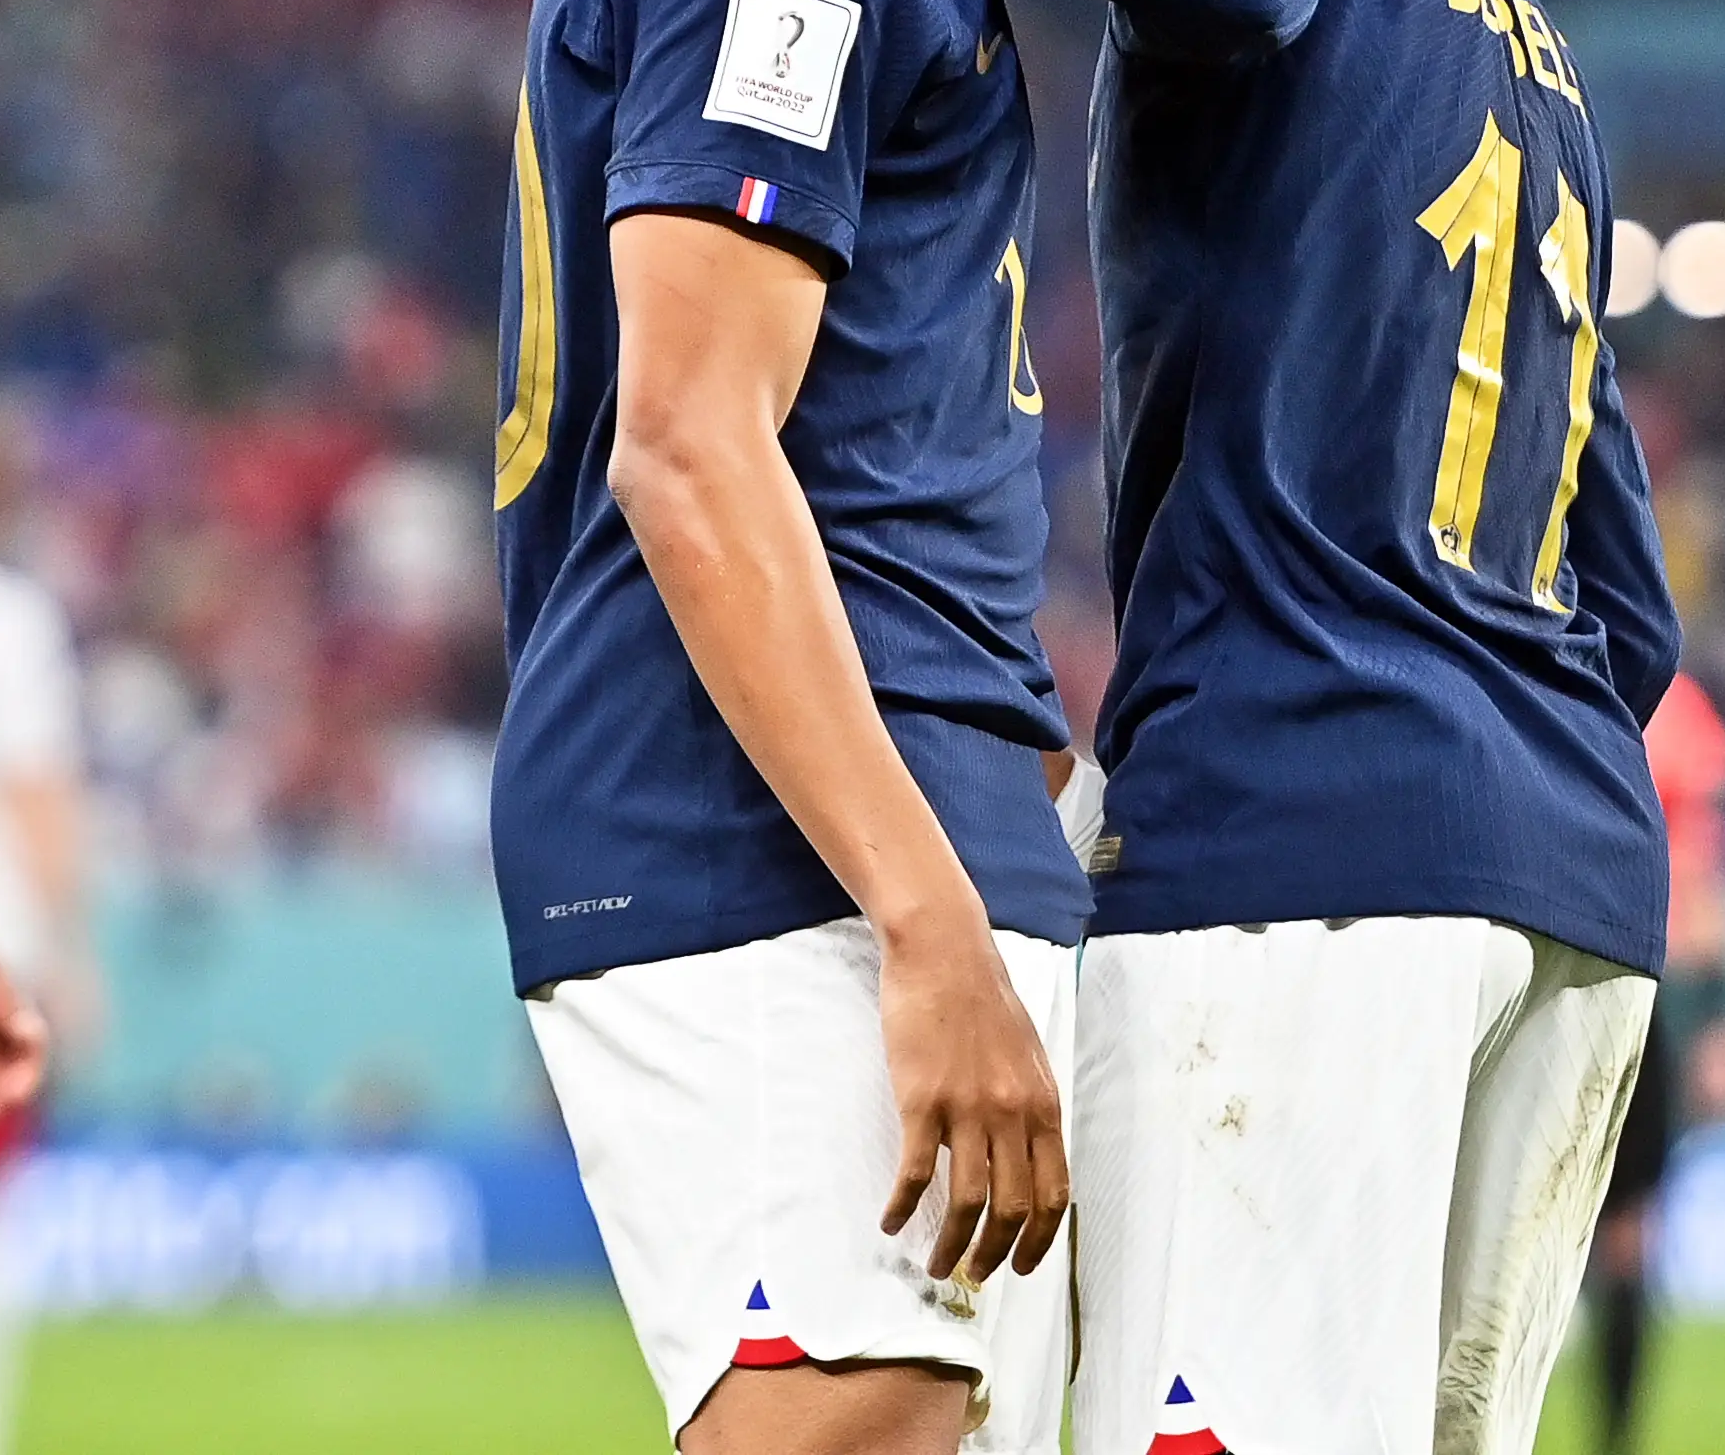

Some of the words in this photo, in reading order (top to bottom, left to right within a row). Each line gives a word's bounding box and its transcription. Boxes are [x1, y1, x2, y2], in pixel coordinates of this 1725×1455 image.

[758, 81, 793, 98] WORLD
[794, 92, 813, 103] CUP
[1415, 107, 1598, 614] 11
